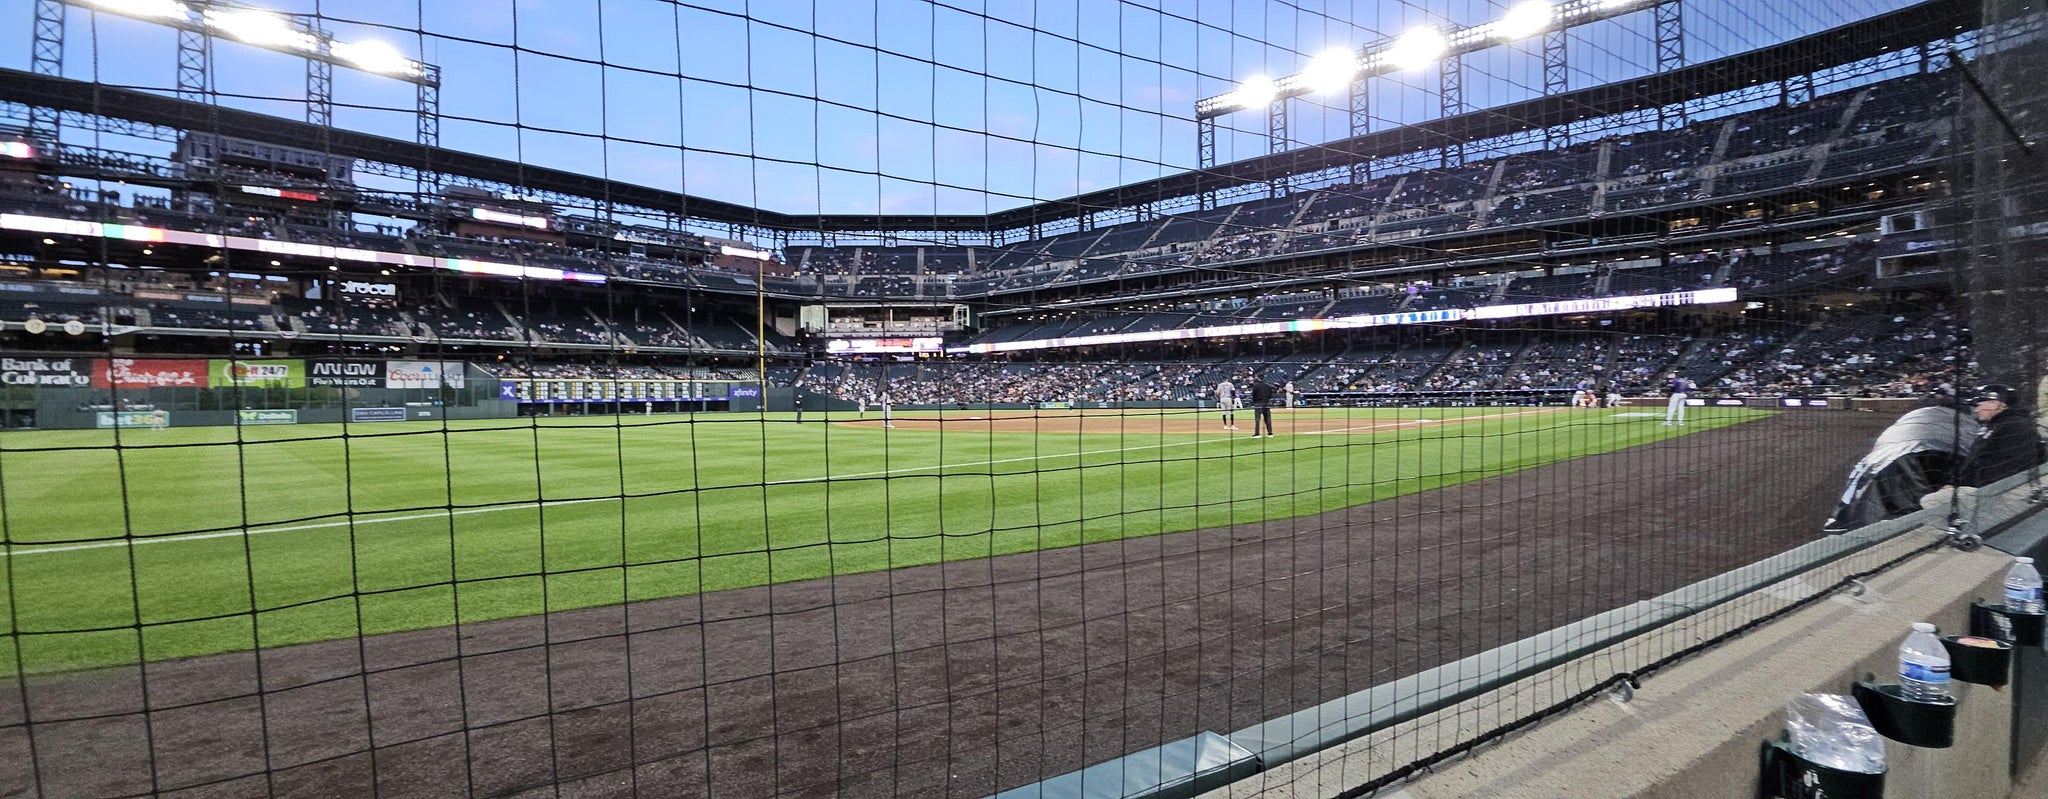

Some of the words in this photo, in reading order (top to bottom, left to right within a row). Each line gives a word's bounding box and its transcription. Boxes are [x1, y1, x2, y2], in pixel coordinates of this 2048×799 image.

[1, 358, 50, 372] Bank
[52, 358, 73, 371] of
[261, 366, 287, 376] 24/7
[733, 388, 758, 397] xfinity
